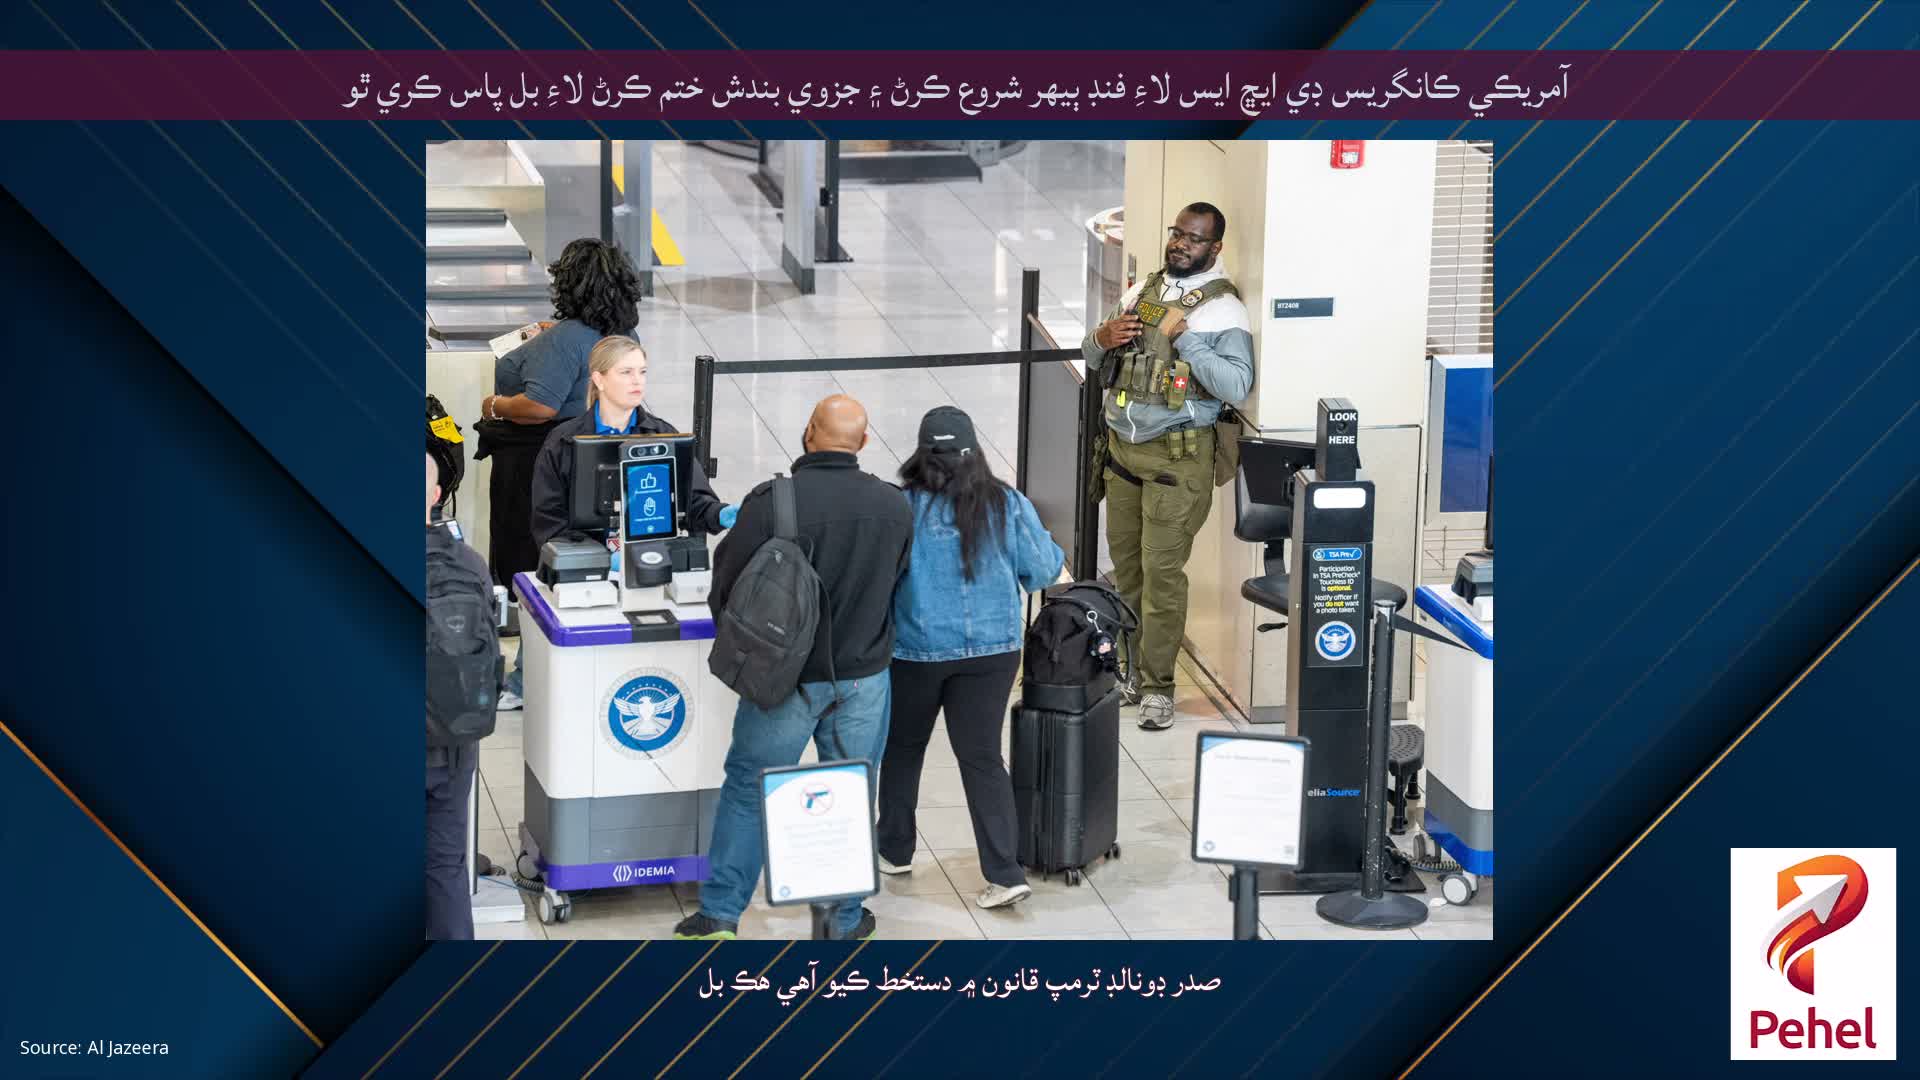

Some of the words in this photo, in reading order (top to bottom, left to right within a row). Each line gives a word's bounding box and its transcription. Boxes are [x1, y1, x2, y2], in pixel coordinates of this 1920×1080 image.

[1138, 302, 1165, 318] POLICE
[1329, 412, 1357, 421] LOOK
[1328, 435, 1356, 444] HERE
[1307, 788, 1361, 797] eliaSource
[634, 865, 675, 877] IDEMIA
